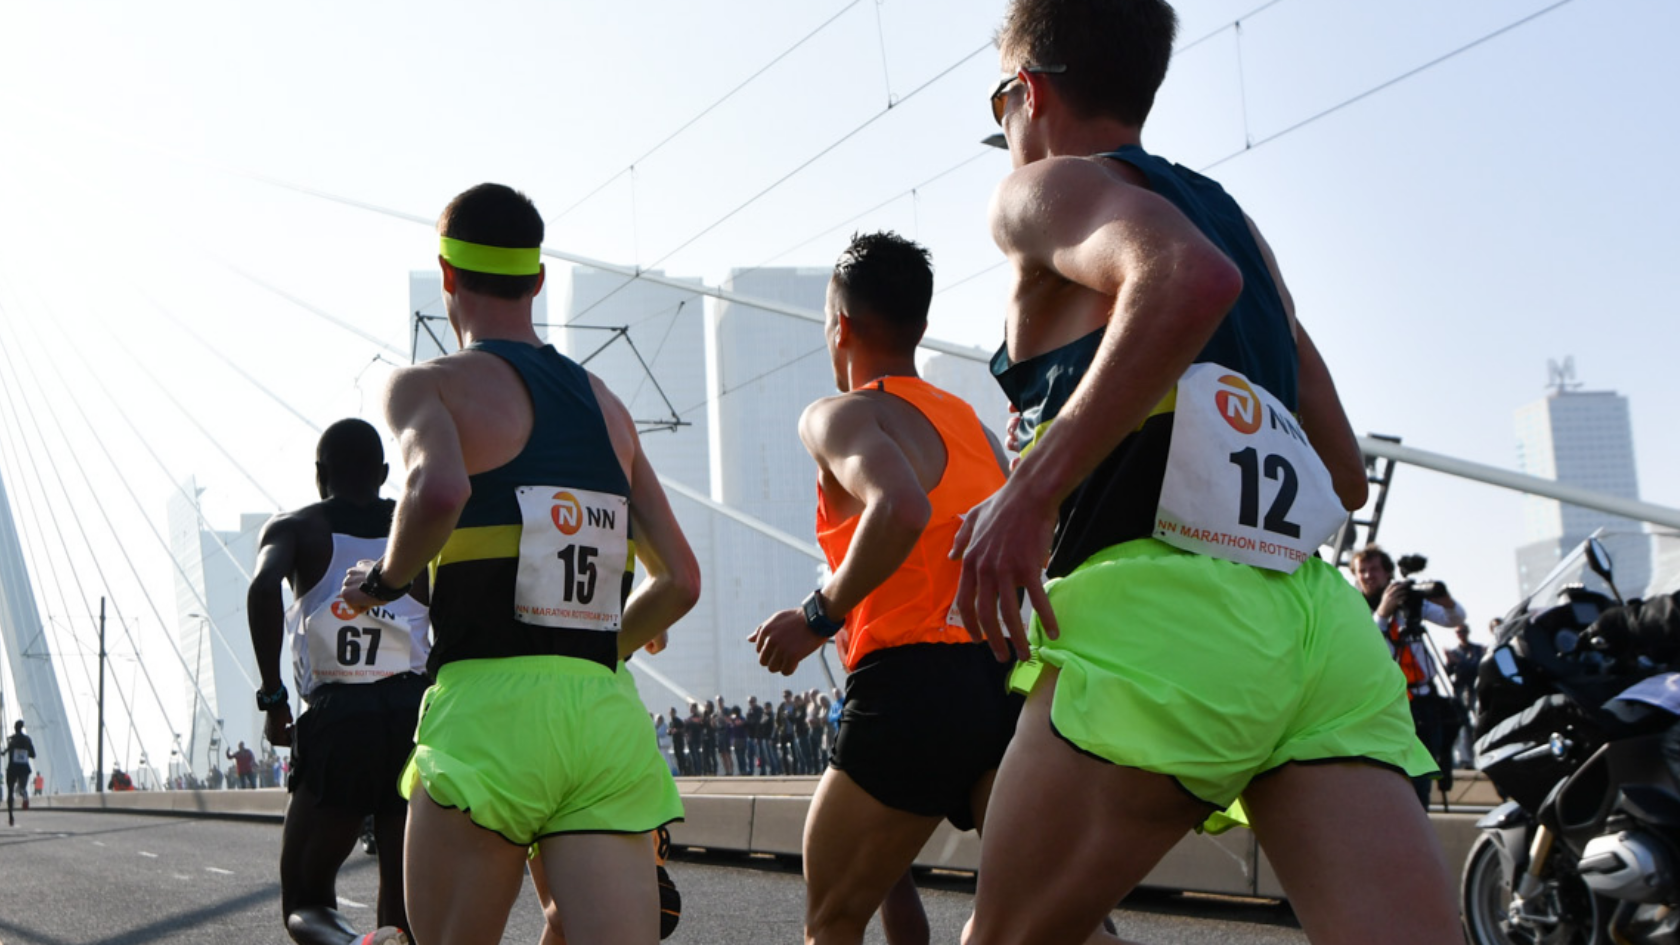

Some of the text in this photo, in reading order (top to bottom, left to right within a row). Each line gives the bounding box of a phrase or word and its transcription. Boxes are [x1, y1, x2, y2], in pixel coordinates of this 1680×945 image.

[1266, 403, 1308, 447] NN
[1229, 446, 1300, 540] 12
[585, 506, 615, 530] NN
[1158, 519, 1176, 532] NN
[1180, 525, 1256, 551] MARATHON
[557, 543, 599, 605] 15
[516, 604, 619, 622] NN MARATHON ROTTERDAM 2017
[336, 625, 382, 667] 67
[322, 669, 353, 677] MARATHON
